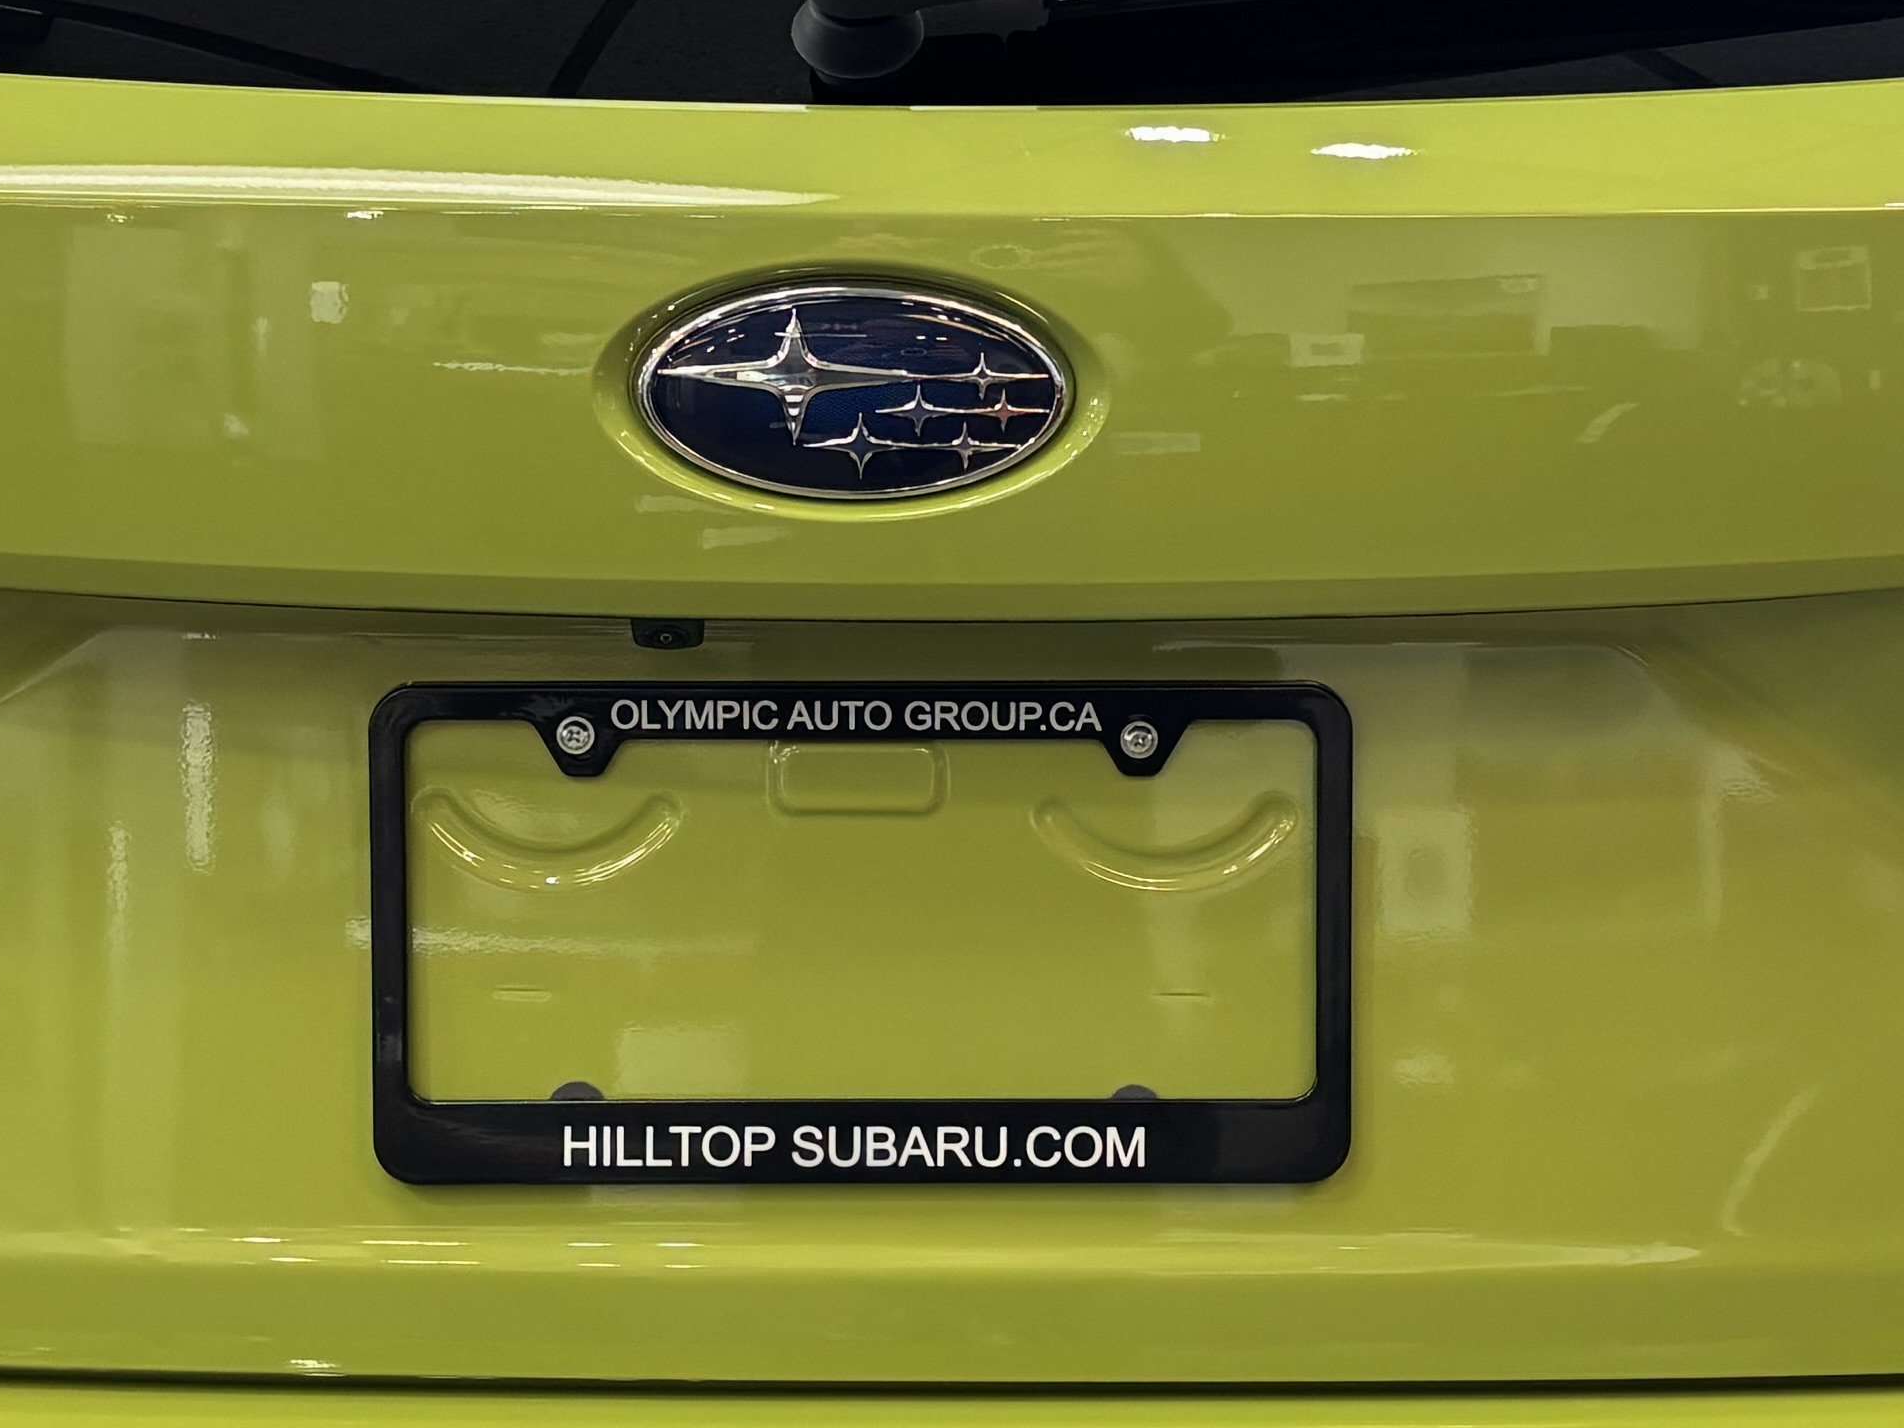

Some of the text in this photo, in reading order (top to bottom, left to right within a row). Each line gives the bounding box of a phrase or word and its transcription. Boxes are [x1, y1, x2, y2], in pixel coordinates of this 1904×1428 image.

[611, 700, 1102, 731] OLYMPIC AUTO GROUP.CA
[562, 1126, 1146, 1168] HILLTOP SUBARU.COM
